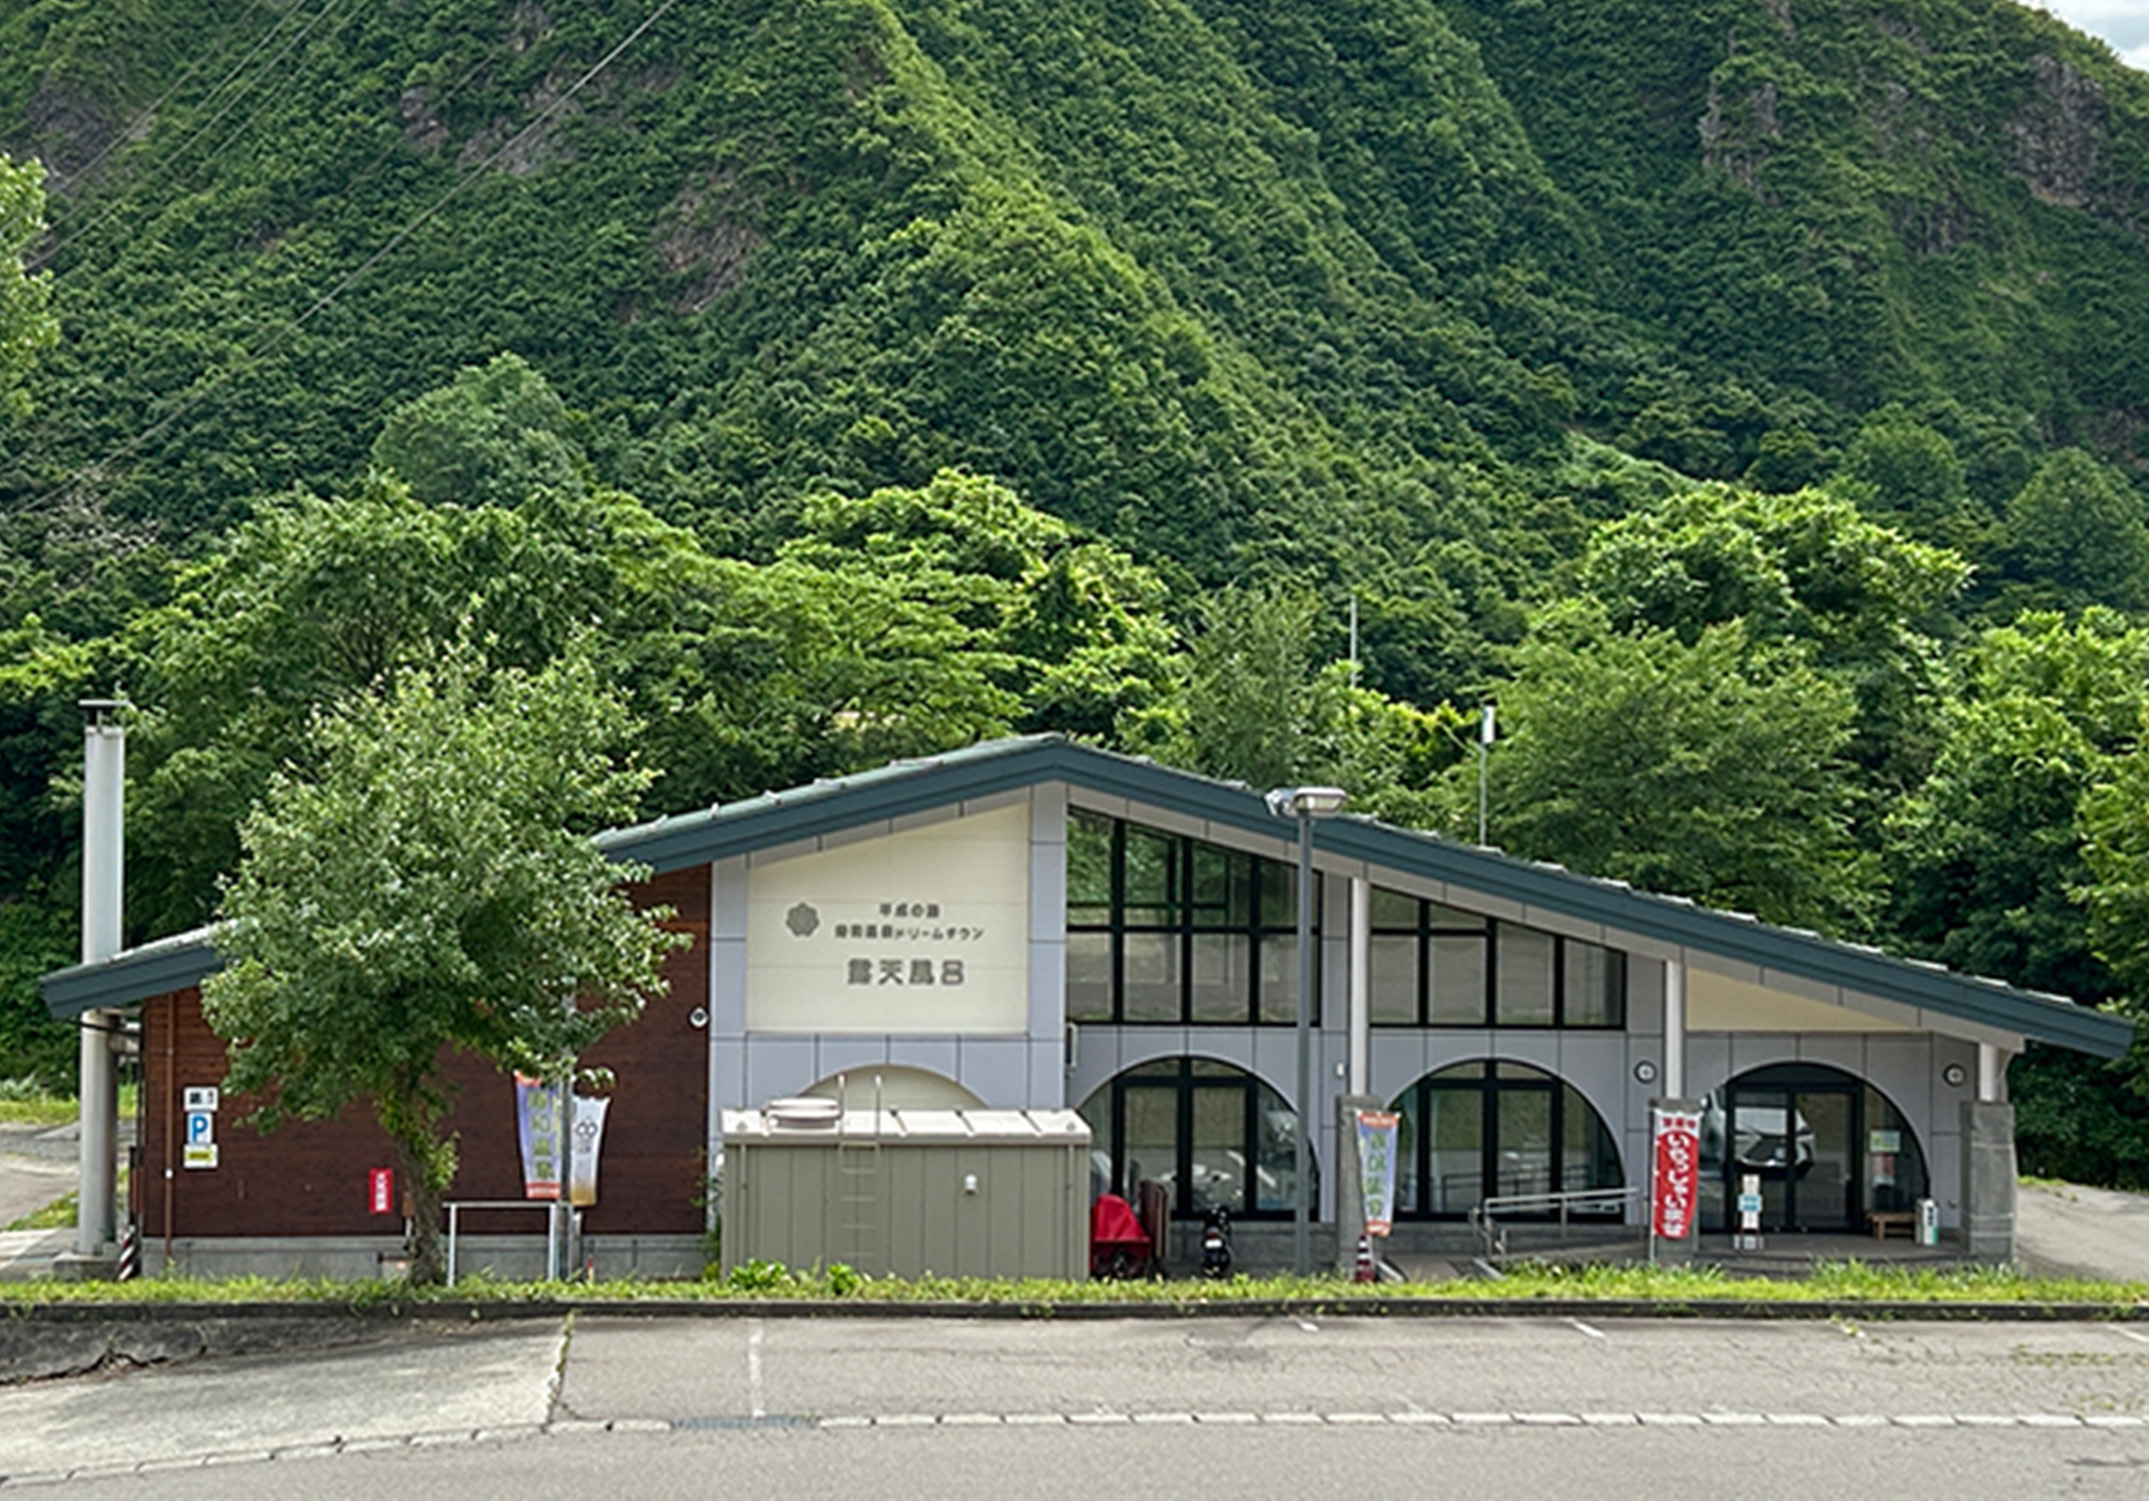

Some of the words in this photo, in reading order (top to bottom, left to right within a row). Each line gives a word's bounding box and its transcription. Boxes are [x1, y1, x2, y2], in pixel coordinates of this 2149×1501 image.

[848, 958, 965, 985] 露天風呂
[193, 1115, 208, 1142] P
